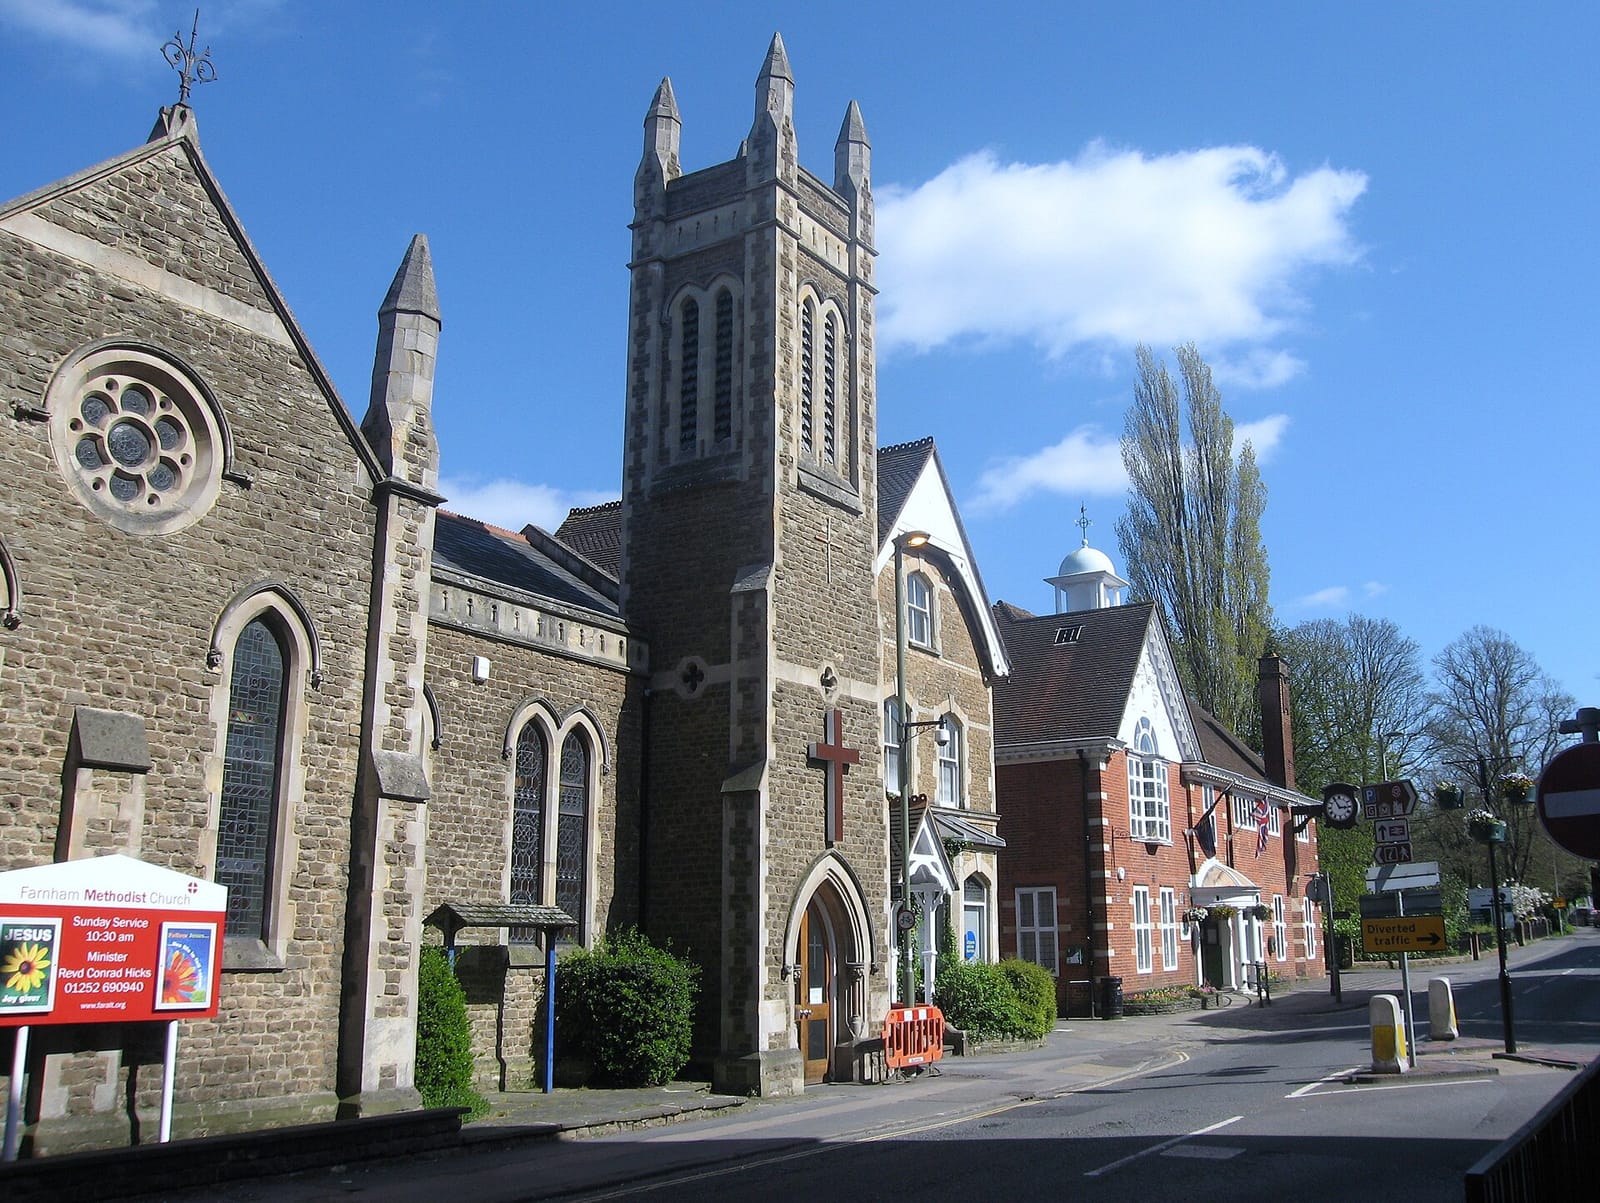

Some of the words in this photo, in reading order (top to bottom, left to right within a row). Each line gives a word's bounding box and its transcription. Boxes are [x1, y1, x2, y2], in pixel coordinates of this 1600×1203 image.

[1366, 790, 1373, 801] P
[20, 886, 80, 901] Farnham
[84, 889, 147, 904] Methodist
[149, 891, 191, 905] Church
[72, 915, 111, 929] Sunday
[112, 917, 149, 928] Service
[1367, 923, 1416, 934] Diverted
[4, 928, 53, 942] JESUS
[85, 931, 116, 942] 10:30
[118, 933, 135, 942] am
[1374, 935, 1410, 946] traffic
[87, 951, 128, 962] Minister
[58, 967, 85, 979] Revd
[86, 967, 123, 978] Conrad
[124, 967, 152, 978] Hicks
[64, 982, 100, 994] 01252
[102, 981, 144, 993] 690940
